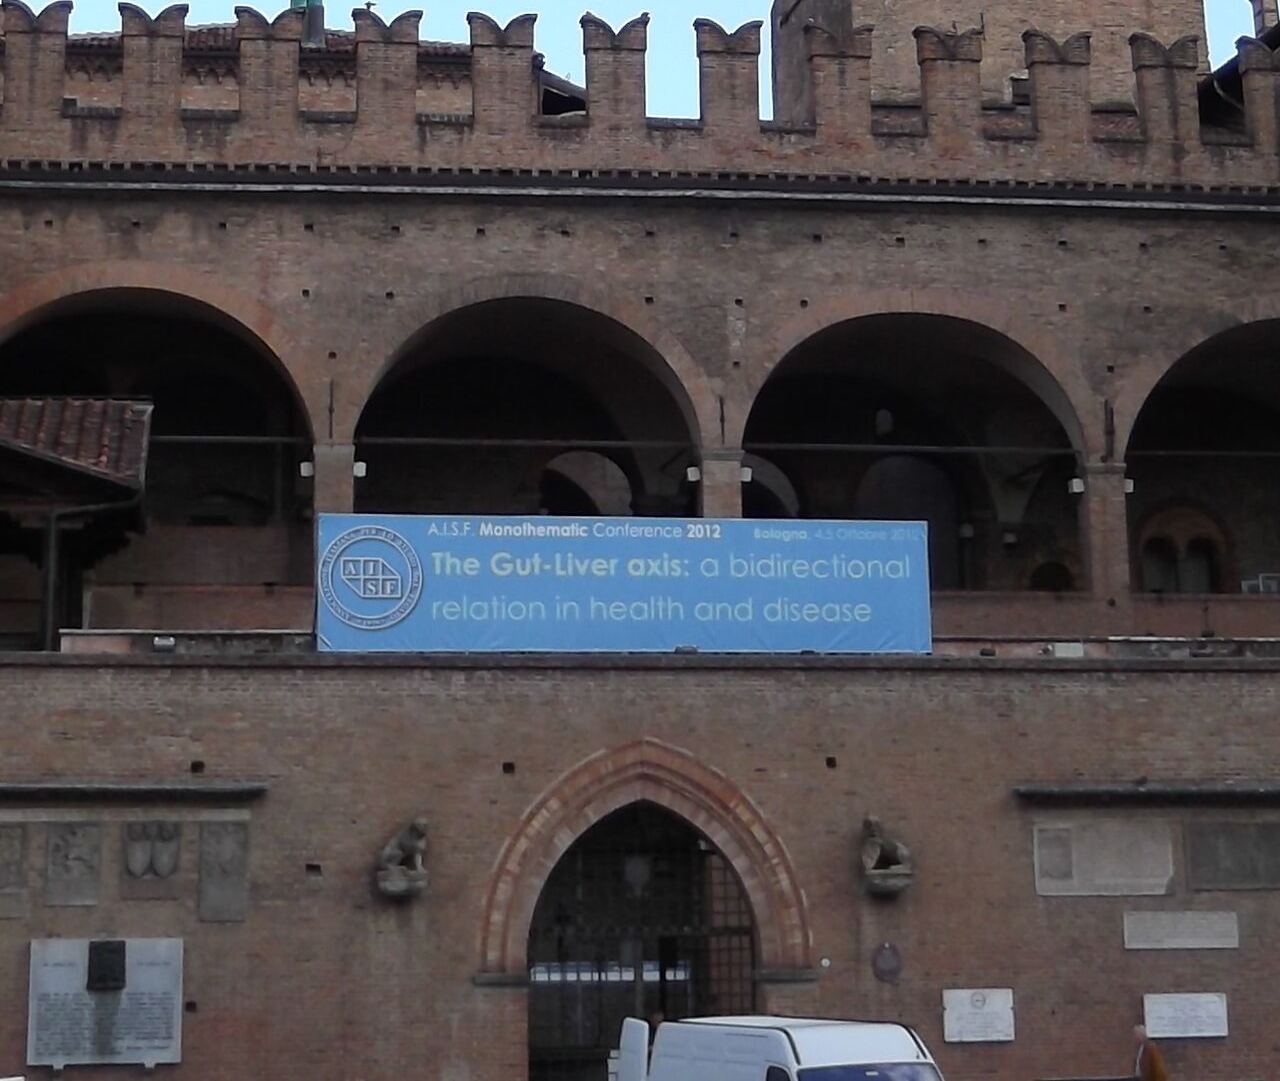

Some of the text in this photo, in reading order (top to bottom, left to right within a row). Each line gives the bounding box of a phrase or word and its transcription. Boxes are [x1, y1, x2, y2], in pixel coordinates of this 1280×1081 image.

[479, 522, 588, 537] Monothematic
[592, 523, 682, 538] Conference
[687, 524, 721, 538] 2012
[431, 551, 910, 578] The Gut-Liver axis: a bidirectional
[432, 595, 871, 622] relation in health and disease
